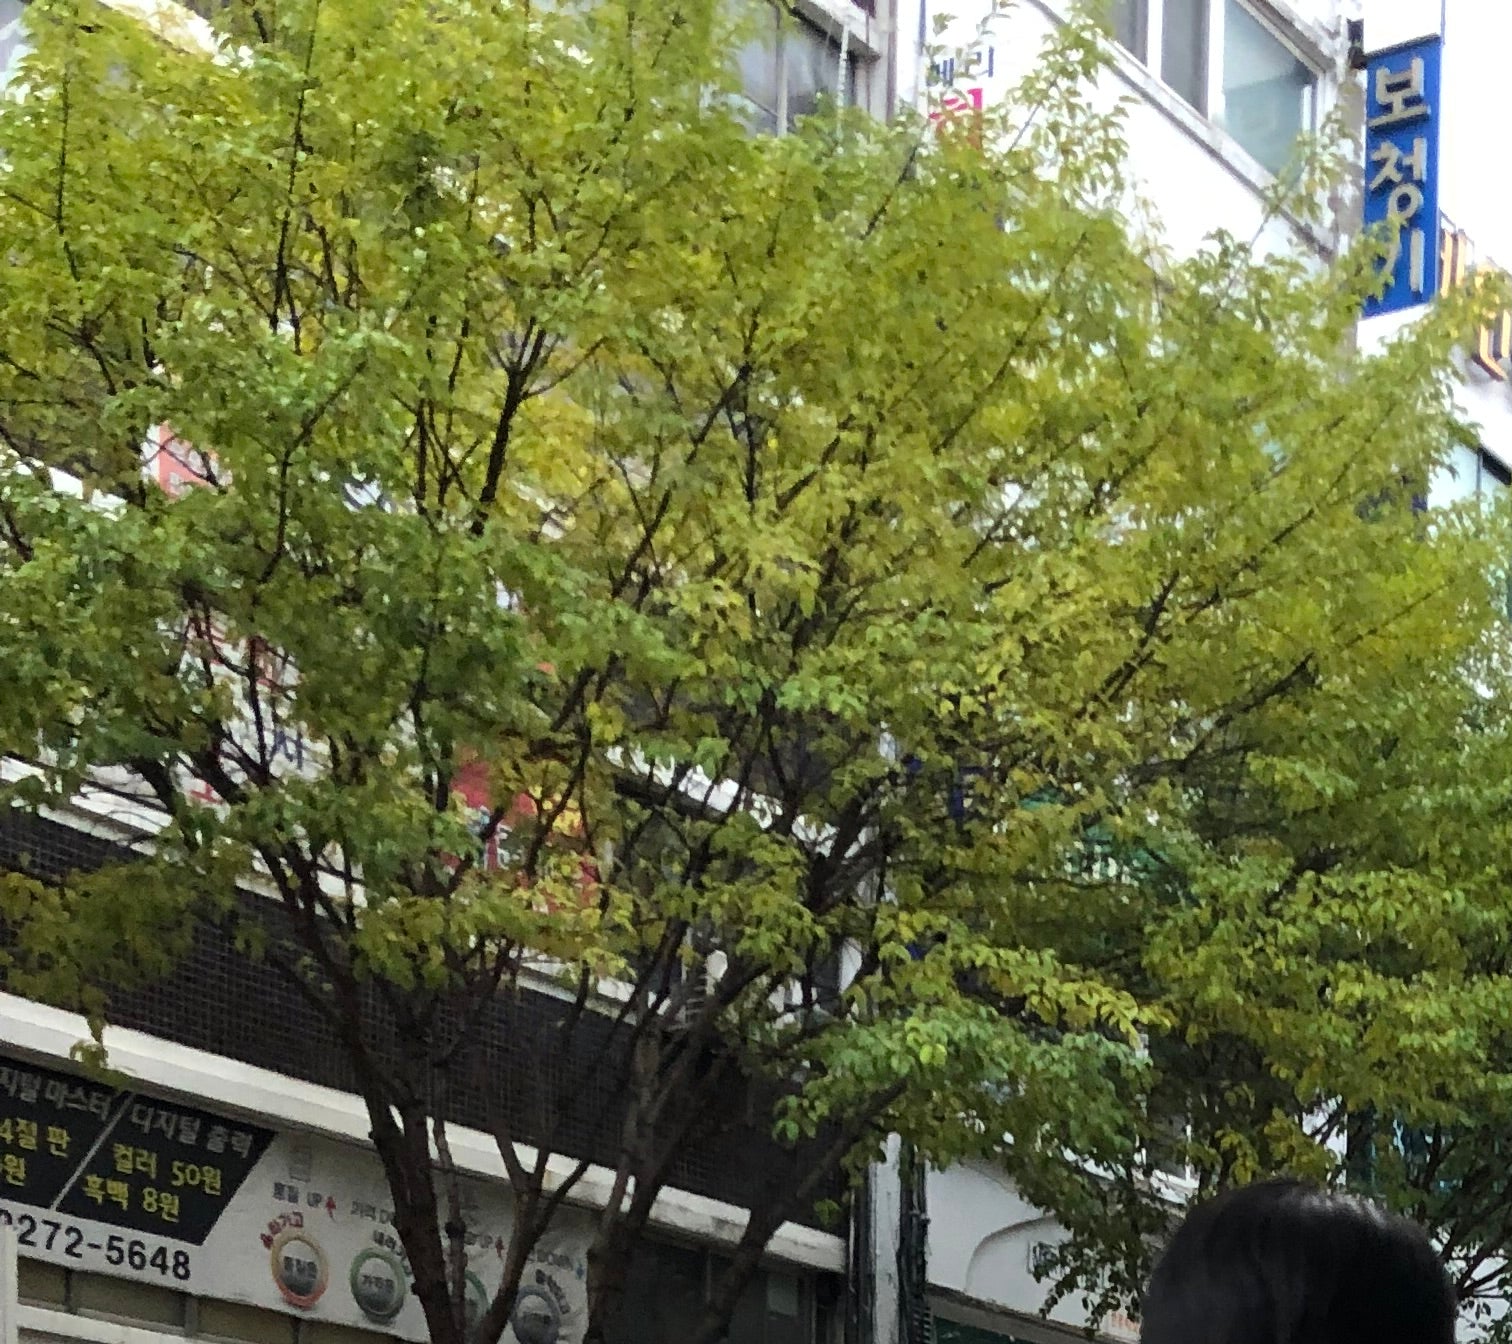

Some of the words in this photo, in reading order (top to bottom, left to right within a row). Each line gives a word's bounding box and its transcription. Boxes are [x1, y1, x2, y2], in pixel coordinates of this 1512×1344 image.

[131, 1103, 201, 1146] 디지털
[113, 1143, 157, 1180] 컬러
[170, 1160, 222, 1196] 50원
[142, 1186, 181, 1223] 8원
